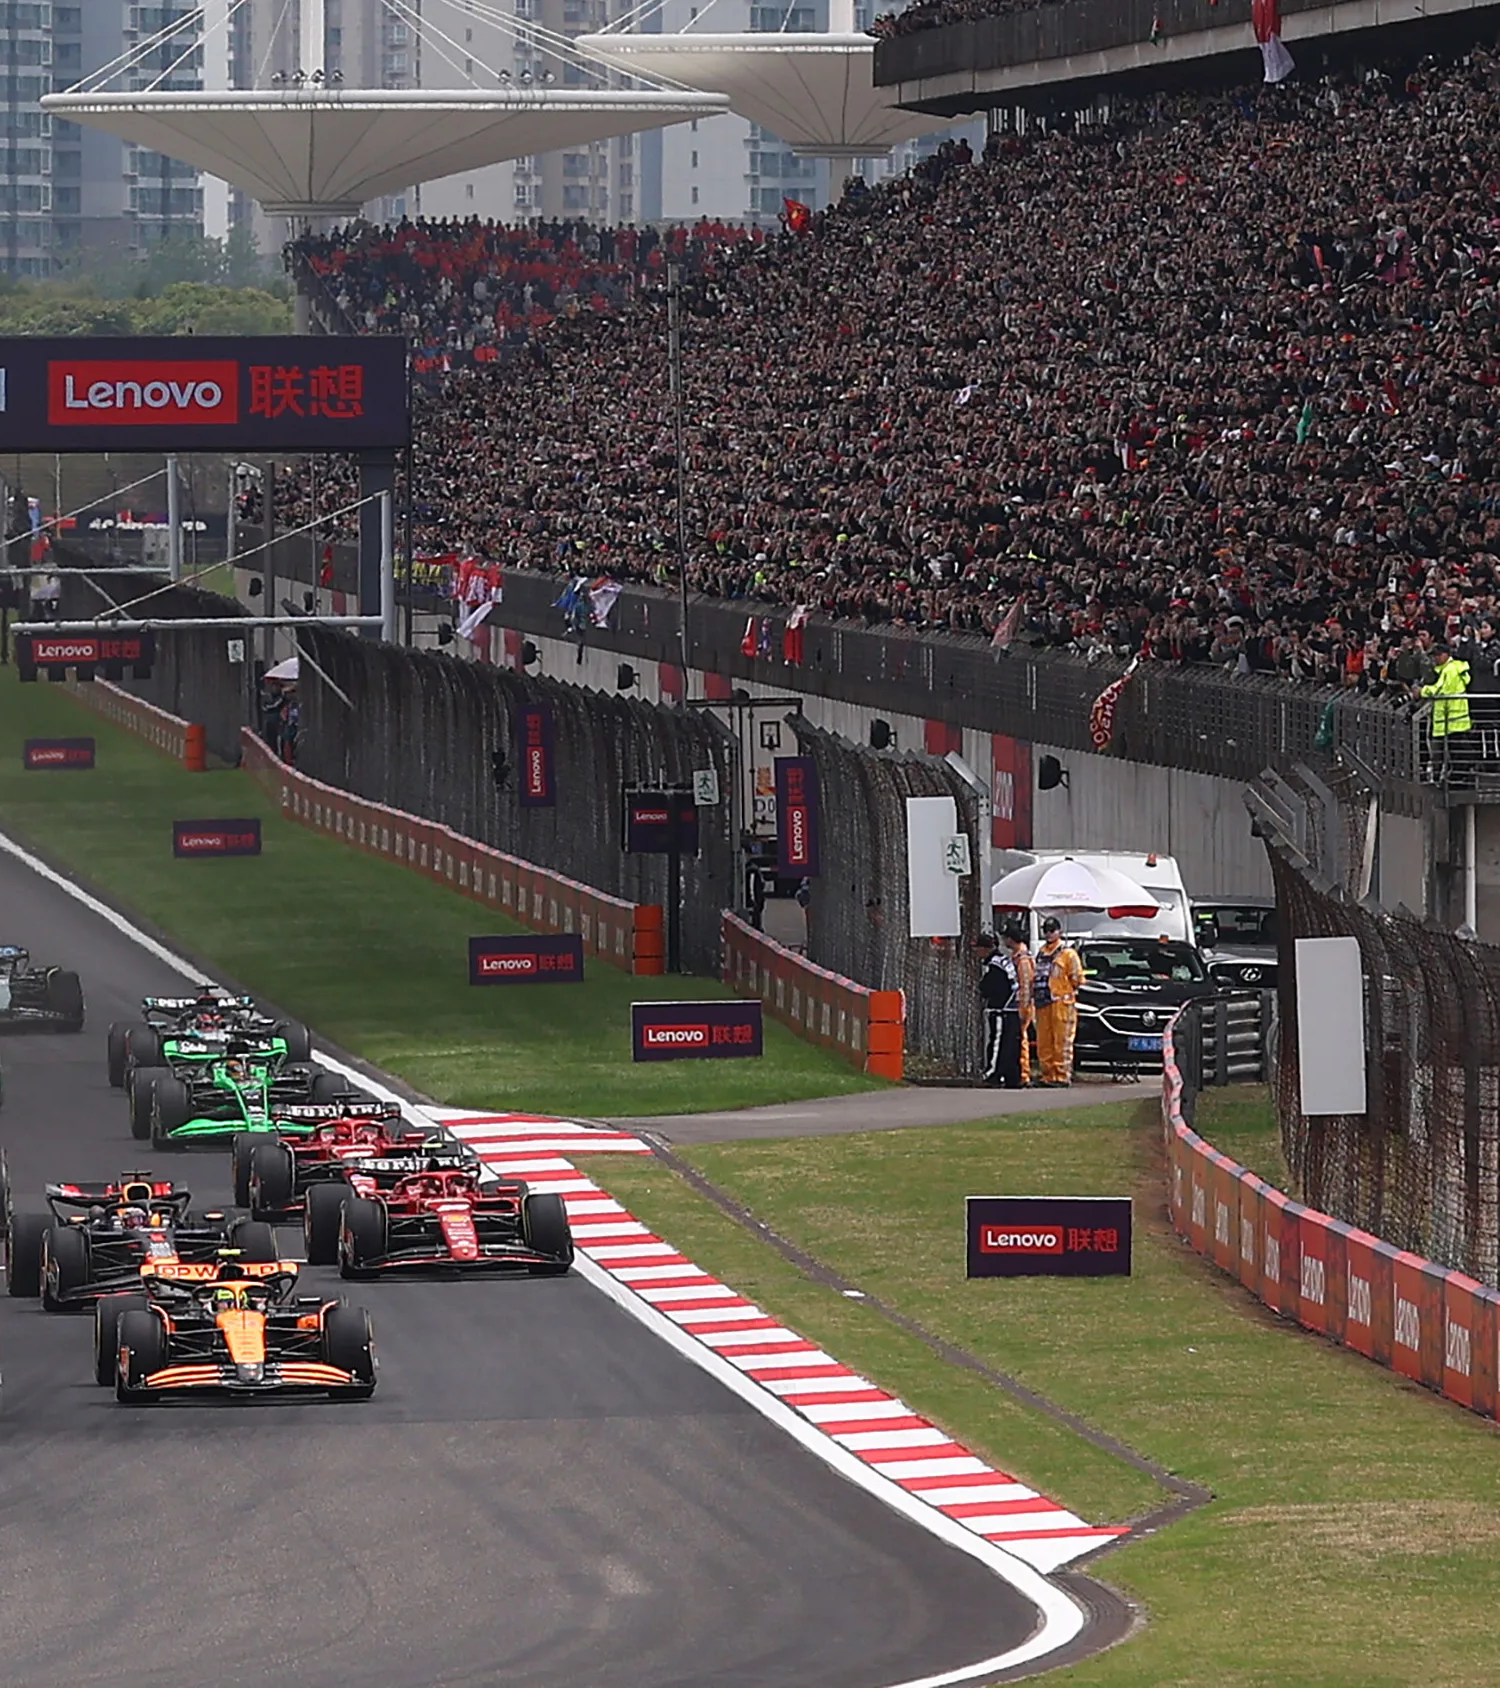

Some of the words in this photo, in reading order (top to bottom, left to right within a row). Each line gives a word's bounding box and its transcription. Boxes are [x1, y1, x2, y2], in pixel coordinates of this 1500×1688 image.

[64, 374, 223, 410] Lenovo
[249, 365, 364, 419] 联想
[37, 643, 94, 658] Lenovo
[531, 750, 542, 793] Lenovo
[792, 810, 804, 861] Lenovo
[482, 957, 532, 970] Lenovo
[647, 1028, 704, 1043] Lenovo
[987, 1229, 1057, 1248] Lenovo
[1068, 1227, 1119, 1253] 联想
